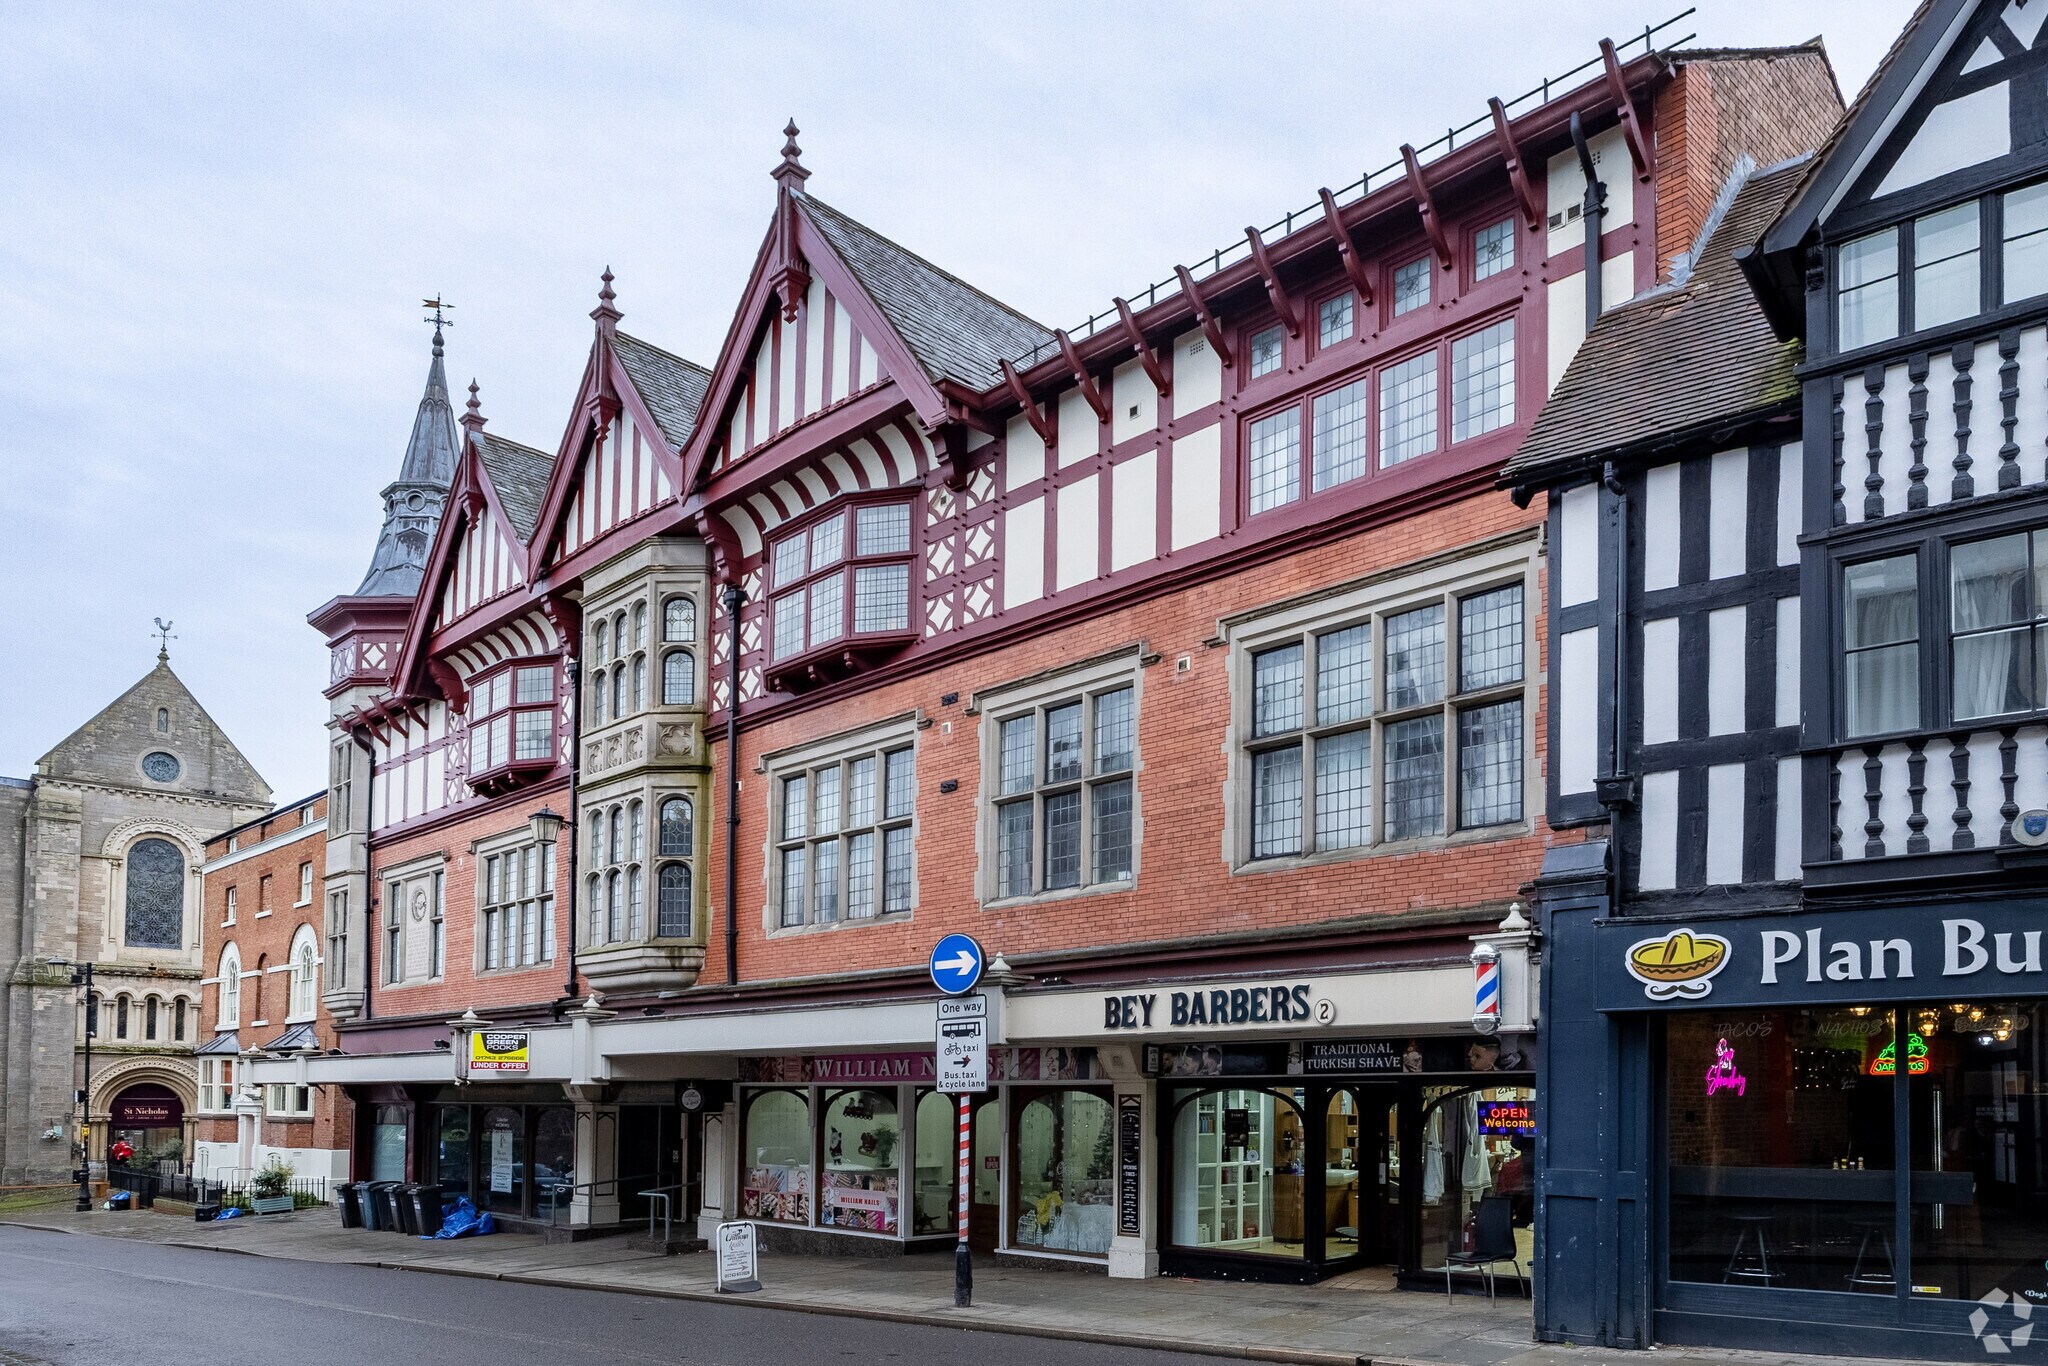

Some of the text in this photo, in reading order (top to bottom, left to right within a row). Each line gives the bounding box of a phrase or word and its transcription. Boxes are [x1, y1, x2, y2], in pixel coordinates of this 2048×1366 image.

[1760, 927, 1914, 984] Plan
[942, 1003, 982, 1013] One way
[1104, 984, 1329, 1029] BEY BARBERS 2
[1713, 1021, 1772, 1037] TACOS
[1816, 1019, 1883, 1037] NACHOS
[963, 1044, 979, 1052] taxi
[1312, 1043, 1394, 1056] TRADITIONAL
[815, 1058, 910, 1077] WILLIAM
[1306, 1056, 1400, 1069] TURKISH SHAVE
[945, 1081, 966, 1089] cycle
[1491, 1108, 1528, 1118] OPEN
[1484, 1118, 1535, 1128] Welcome
[840, 1197, 863, 1205] WILLIAM
